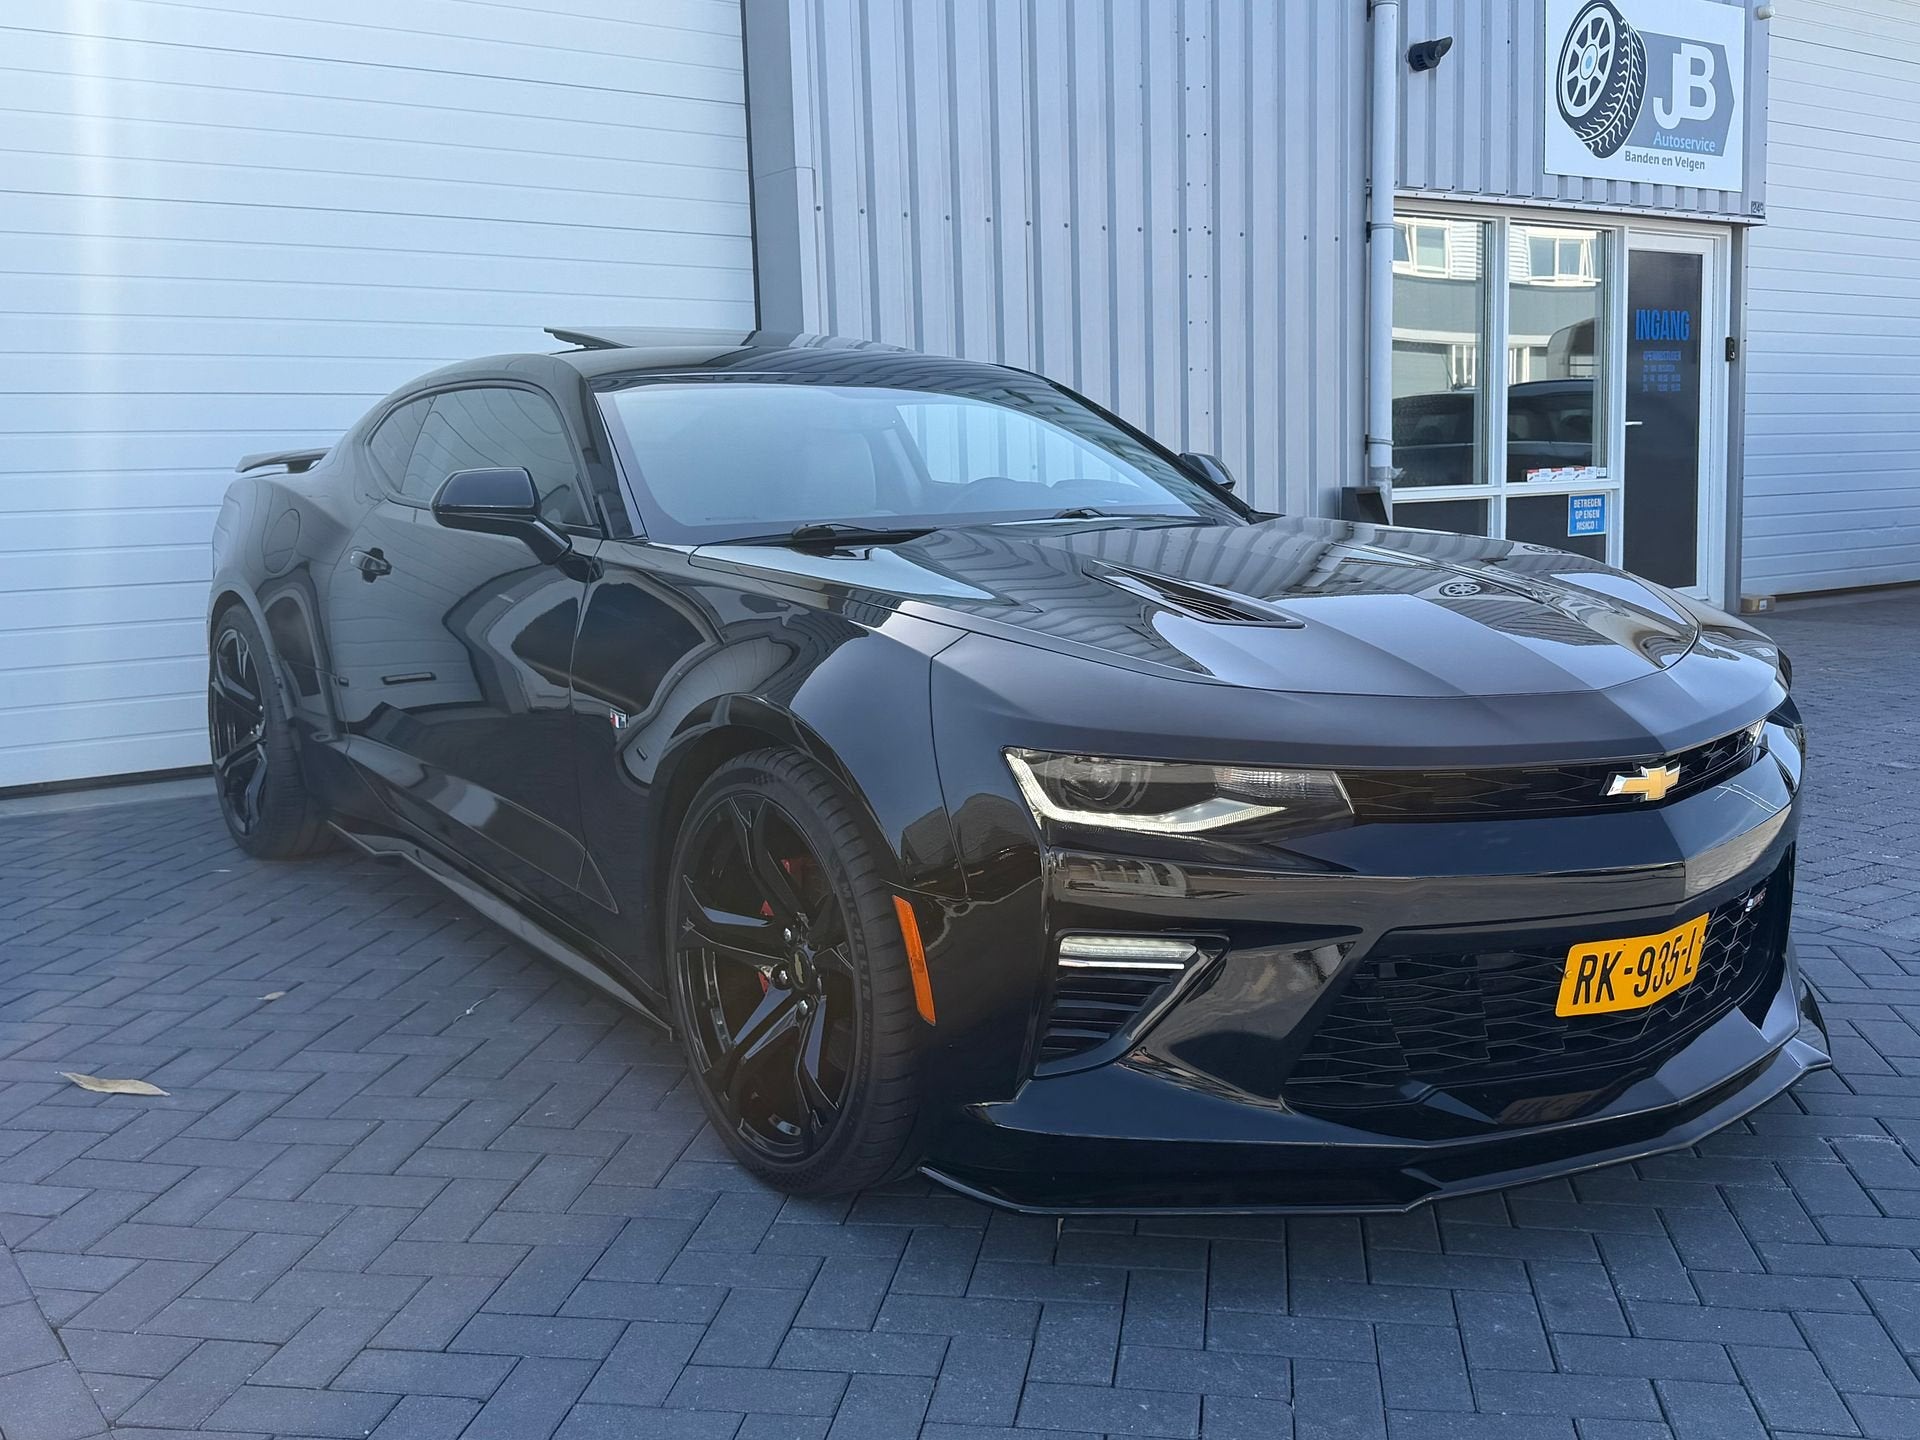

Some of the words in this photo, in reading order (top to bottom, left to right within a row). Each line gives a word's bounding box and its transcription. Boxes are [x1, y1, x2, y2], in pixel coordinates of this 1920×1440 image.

[1653, 42, 1716, 129] JB
[1653, 131, 1716, 152] Autoservice
[1624, 150, 1660, 165] Banden
[1661, 156, 1673, 166] en
[1674, 157, 1705, 172] Velgen
[1636, 309, 1690, 341] INGANG
[1573, 498, 1602, 508] BETREDEN
[1575, 510, 1583, 519] OP
[1584, 509, 1600, 519] EIGEN
[1576, 521, 1595, 530] RISICO
[840, 881, 872, 1001] MICHELIN
[1572, 927, 1697, 1005] RK-935-L
[863, 1011, 871, 1048] PILOT
